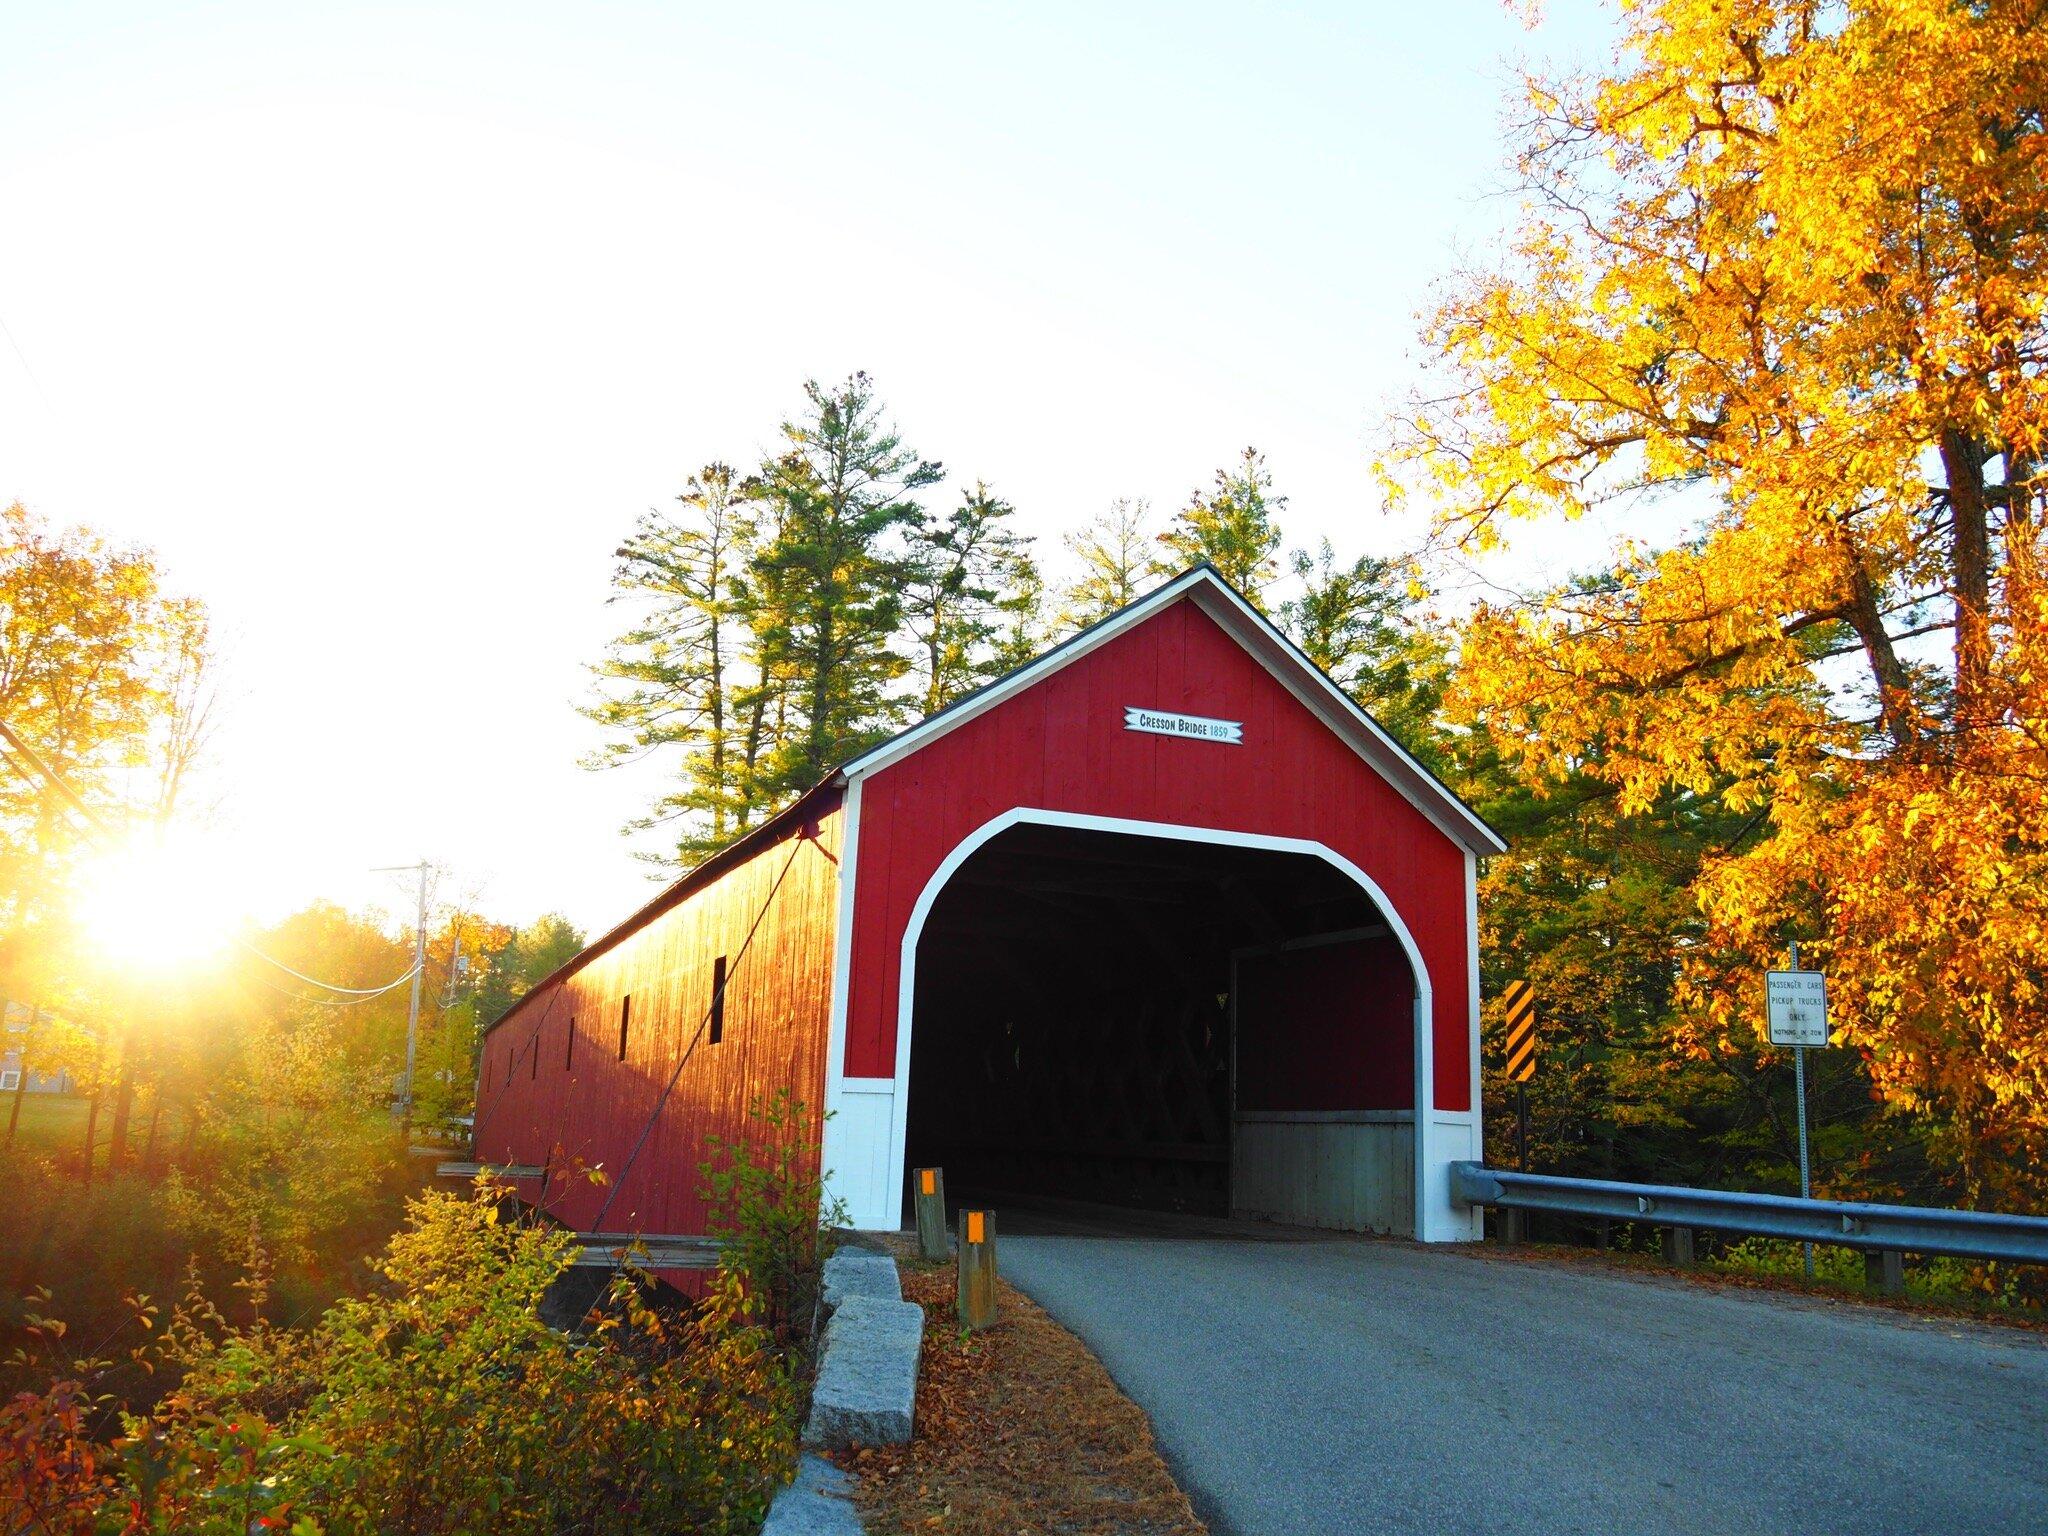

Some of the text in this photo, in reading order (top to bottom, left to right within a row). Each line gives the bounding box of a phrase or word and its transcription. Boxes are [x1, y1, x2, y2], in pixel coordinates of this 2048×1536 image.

[1140, 713, 1228, 739] CRESSON BRIDGE 1859
[1769, 981, 1822, 990] PASSENGER CARS
[1771, 997, 1822, 1006] PICKUP TRUCKS
[1789, 1013, 1806, 1021] ONLY
